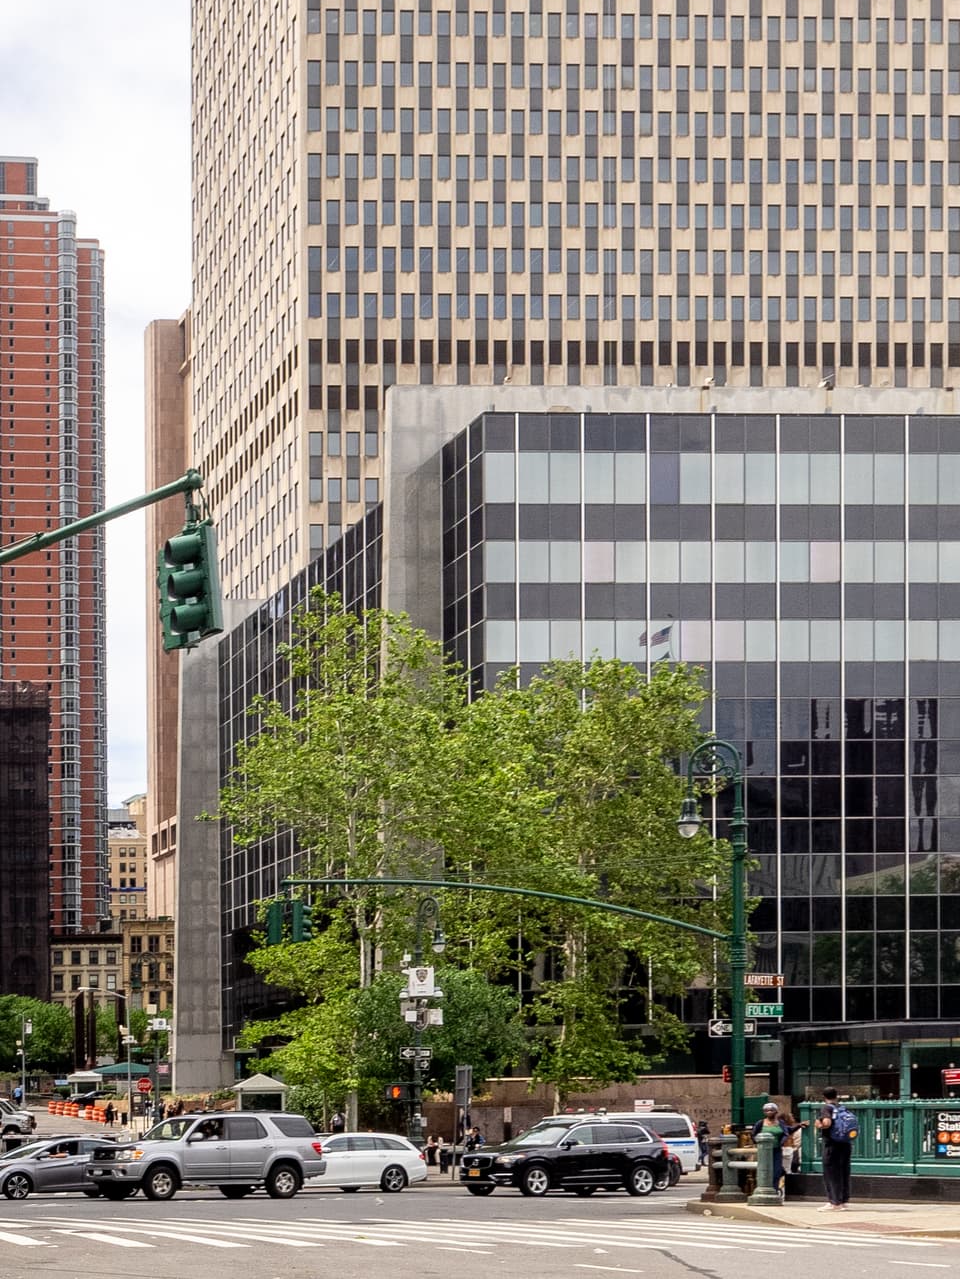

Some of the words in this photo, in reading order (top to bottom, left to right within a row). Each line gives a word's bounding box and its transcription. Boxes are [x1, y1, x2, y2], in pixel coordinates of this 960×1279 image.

[744, 975, 774, 986] LAFAYETTE
[777, 976, 784, 986] ST
[748, 1005, 774, 1015] FOLEY
[715, 1024, 729, 1032] ONE
